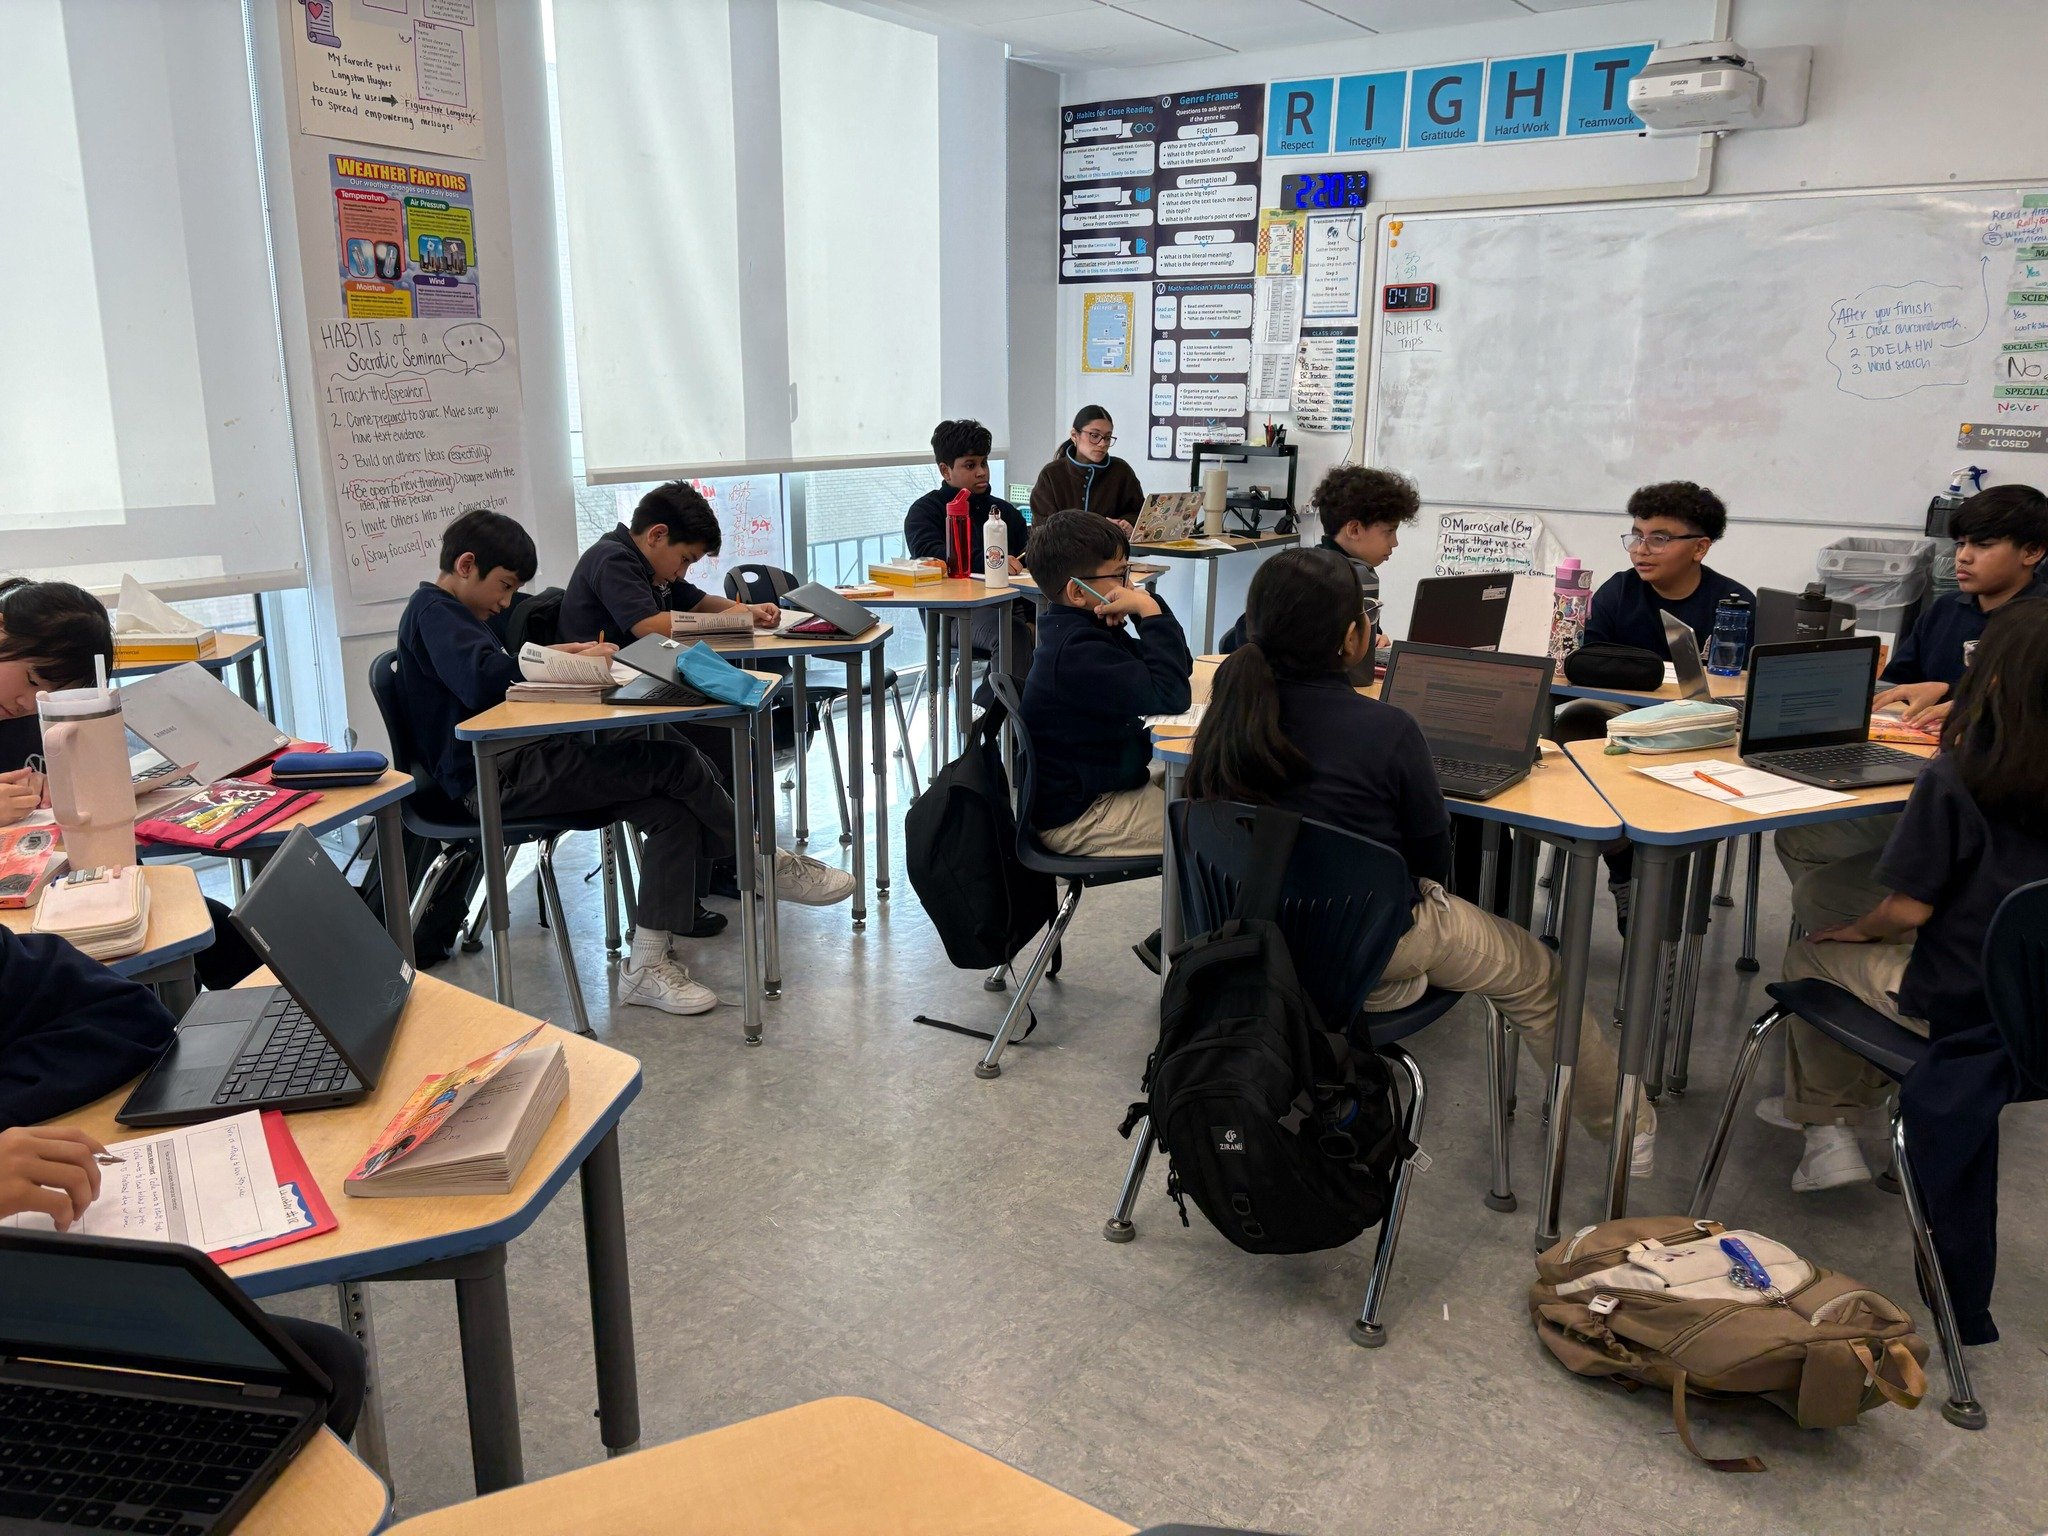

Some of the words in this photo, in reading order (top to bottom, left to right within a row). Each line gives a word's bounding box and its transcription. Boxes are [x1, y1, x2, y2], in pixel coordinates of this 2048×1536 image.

[328, 52, 340, 66] My
[344, 54, 373, 68] favorite
[377, 62, 392, 76] poet
[332, 70, 364, 85] Langston
[367, 75, 391, 89] Hughes
[313, 82, 347, 97] because
[351, 89, 361, 100] he
[1180, 96, 1205, 105] Genre
[1207, 92, 1238, 101] Frames
[1286, 91, 1314, 136] R
[1427, 76, 1462, 125] G
[1505, 68, 1545, 119] H
[1594, 59, 1630, 110] T
[310, 96, 322, 107] to
[365, 109, 414, 130] empowering
[421, 119, 453, 133] messages
[405, 99, 443, 114] Figurative
[446, 107, 476, 124] Language
[1126, 106, 1153, 114] Reading
[1176, 108, 1200, 116] Questions
[1197, 127, 1217, 135] Fiction
[1280, 140, 1314, 152] Respect
[1349, 135, 1387, 147] Integrity
[1420, 127, 1465, 141] Gratitude
[1495, 123, 1521, 135] Hard
[1523, 120, 1550, 133] Work
[1578, 115, 1635, 128] Teamwork
[336, 158, 407, 182] WEATHER
[409, 167, 466, 192] FACTORS
[1185, 176, 1227, 185] Informational
[341, 191, 385, 203] Temperature
[365, 180, 389, 189] weather
[391, 184, 416, 193] changes
[431, 188, 444, 198] daily
[410, 198, 419, 206] Air
[420, 200, 445, 209] Pressure
[1992, 210, 2020, 221] Read
[2026, 265, 2040, 278] Yes
[356, 283, 385, 292] Moisture
[429, 277, 445, 285] Wind
[1837, 307, 1866, 324] After
[1875, 307, 1890, 325] you
[1894, 300, 1932, 315] finish
[2014, 310, 2027, 320] Yes
[392, 323, 406, 347] of
[422, 333, 428, 344] a
[1385, 319, 1420, 336] RIGHT
[1398, 337, 1423, 351] Trips
[1866, 345, 1884, 358] Do
[1887, 342, 1911, 355] ELA
[1915, 339, 1933, 350] HW
[2004, 343, 2032, 351] SOCIAL
[347, 351, 398, 372] Socratic
[402, 347, 447, 367] Seminar
[1868, 358, 1891, 372] Word
[1895, 358, 1930, 370] search
[336, 386, 368, 403] Track
[368, 386, 387, 402] the
[389, 386, 423, 403] speaker
[346, 411, 373, 428] Come
[374, 412, 406, 428] prepared
[405, 407, 418, 421] to
[443, 405, 465, 419] Make
[468, 405, 483, 415] sure
[485, 405, 499, 419] you
[352, 430, 372, 444] have
[374, 430, 392, 443] text
[1981, 428, 2041, 438] BATHROOM
[1988, 439, 2029, 448] CLOSED
[382, 454, 394, 466] on
[425, 449, 445, 463] Ideas
[353, 483, 367, 498] Be
[369, 482, 390, 497] open
[390, 480, 400, 494] to
[401, 478, 418, 491] new
[455, 472, 485, 486] Disagree
[485, 469, 501, 481] with
[503, 467, 515, 477] the
[379, 498, 390, 510] not
[393, 496, 407, 507] the
[408, 494, 433, 507] person
[361, 519, 387, 536] Invite
[391, 513, 419, 528] Others
[440, 505, 455, 518] the
[457, 496, 508, 517] Conversation
[1442, 534, 1470, 544] Things
[1471, 536, 1492, 546] that
[1512, 541, 1527, 549] see
[367, 548, 388, 564] Stay
[388, 540, 421, 558] focused
[425, 539, 436, 549] on
[1484, 548, 1503, 556] eyes
